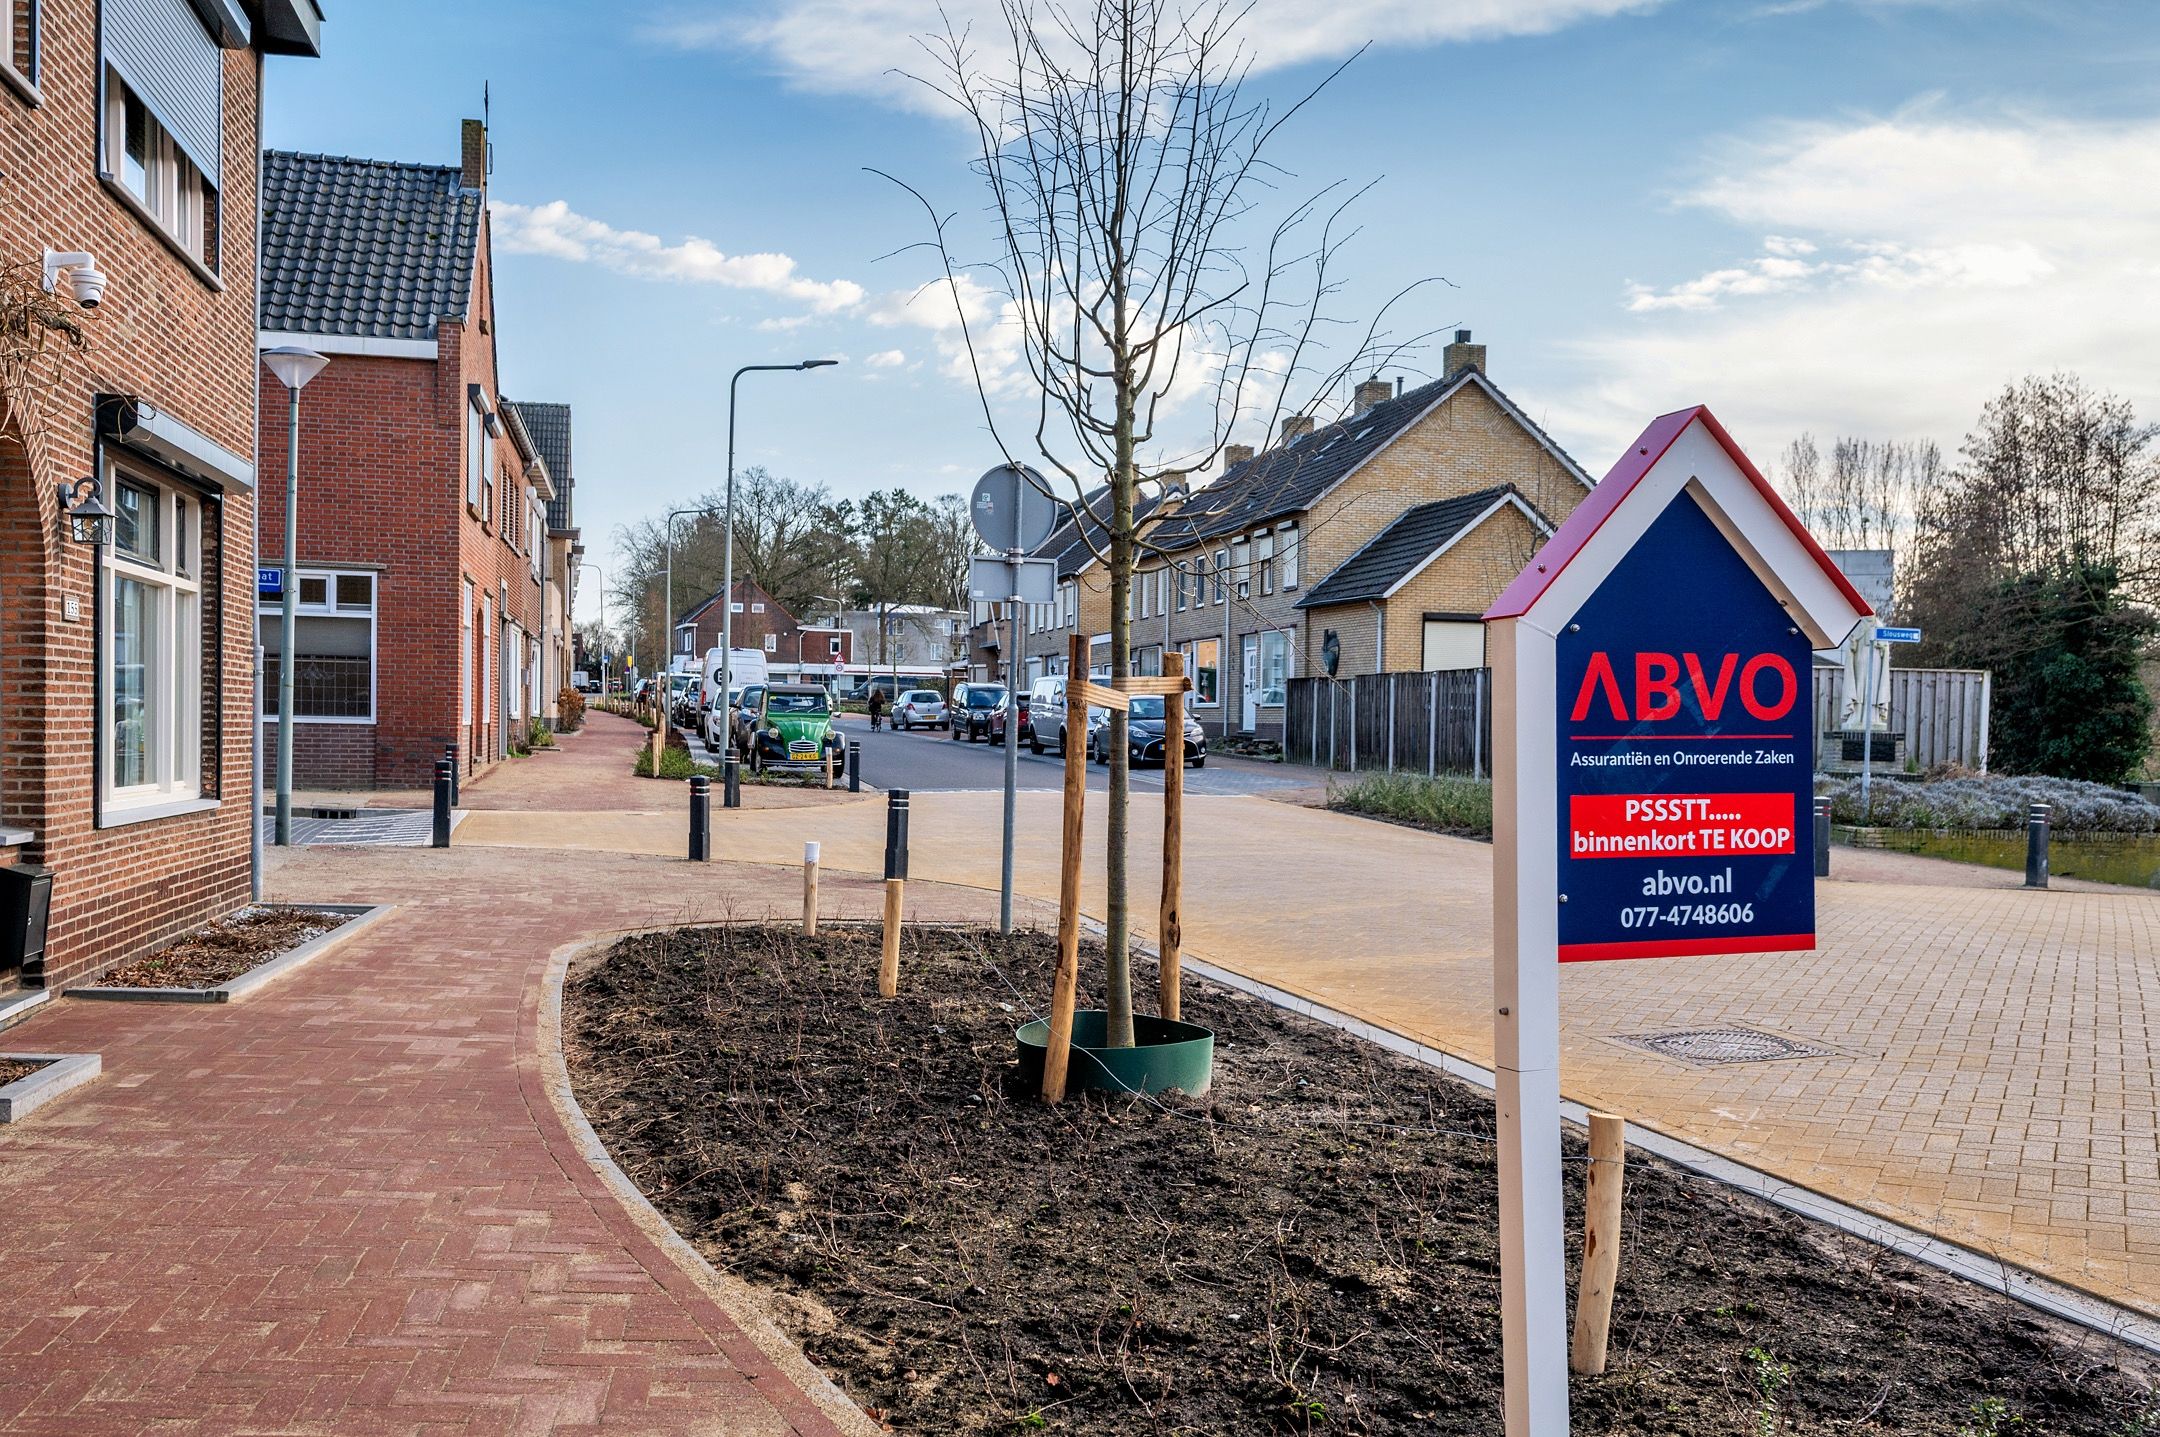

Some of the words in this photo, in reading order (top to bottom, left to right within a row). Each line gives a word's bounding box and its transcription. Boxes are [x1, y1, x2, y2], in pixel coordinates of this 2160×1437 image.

[1570, 651, 1798, 721] ABVO
[1570, 751, 1652, 767] Assurantiën
[1653, 754, 1671, 766] en
[1673, 750, 1753, 765] Onroerende
[1754, 749, 1795, 765] Zaken
[1625, 798, 1742, 822] PSSSTT.....
[1573, 829, 1696, 853] binnenkort
[1699, 828, 1725, 849] TE
[1730, 827, 1791, 849] KOOP
[1642, 867, 1732, 896] abvo.nl
[1620, 902, 1754, 928] 077-4748606
